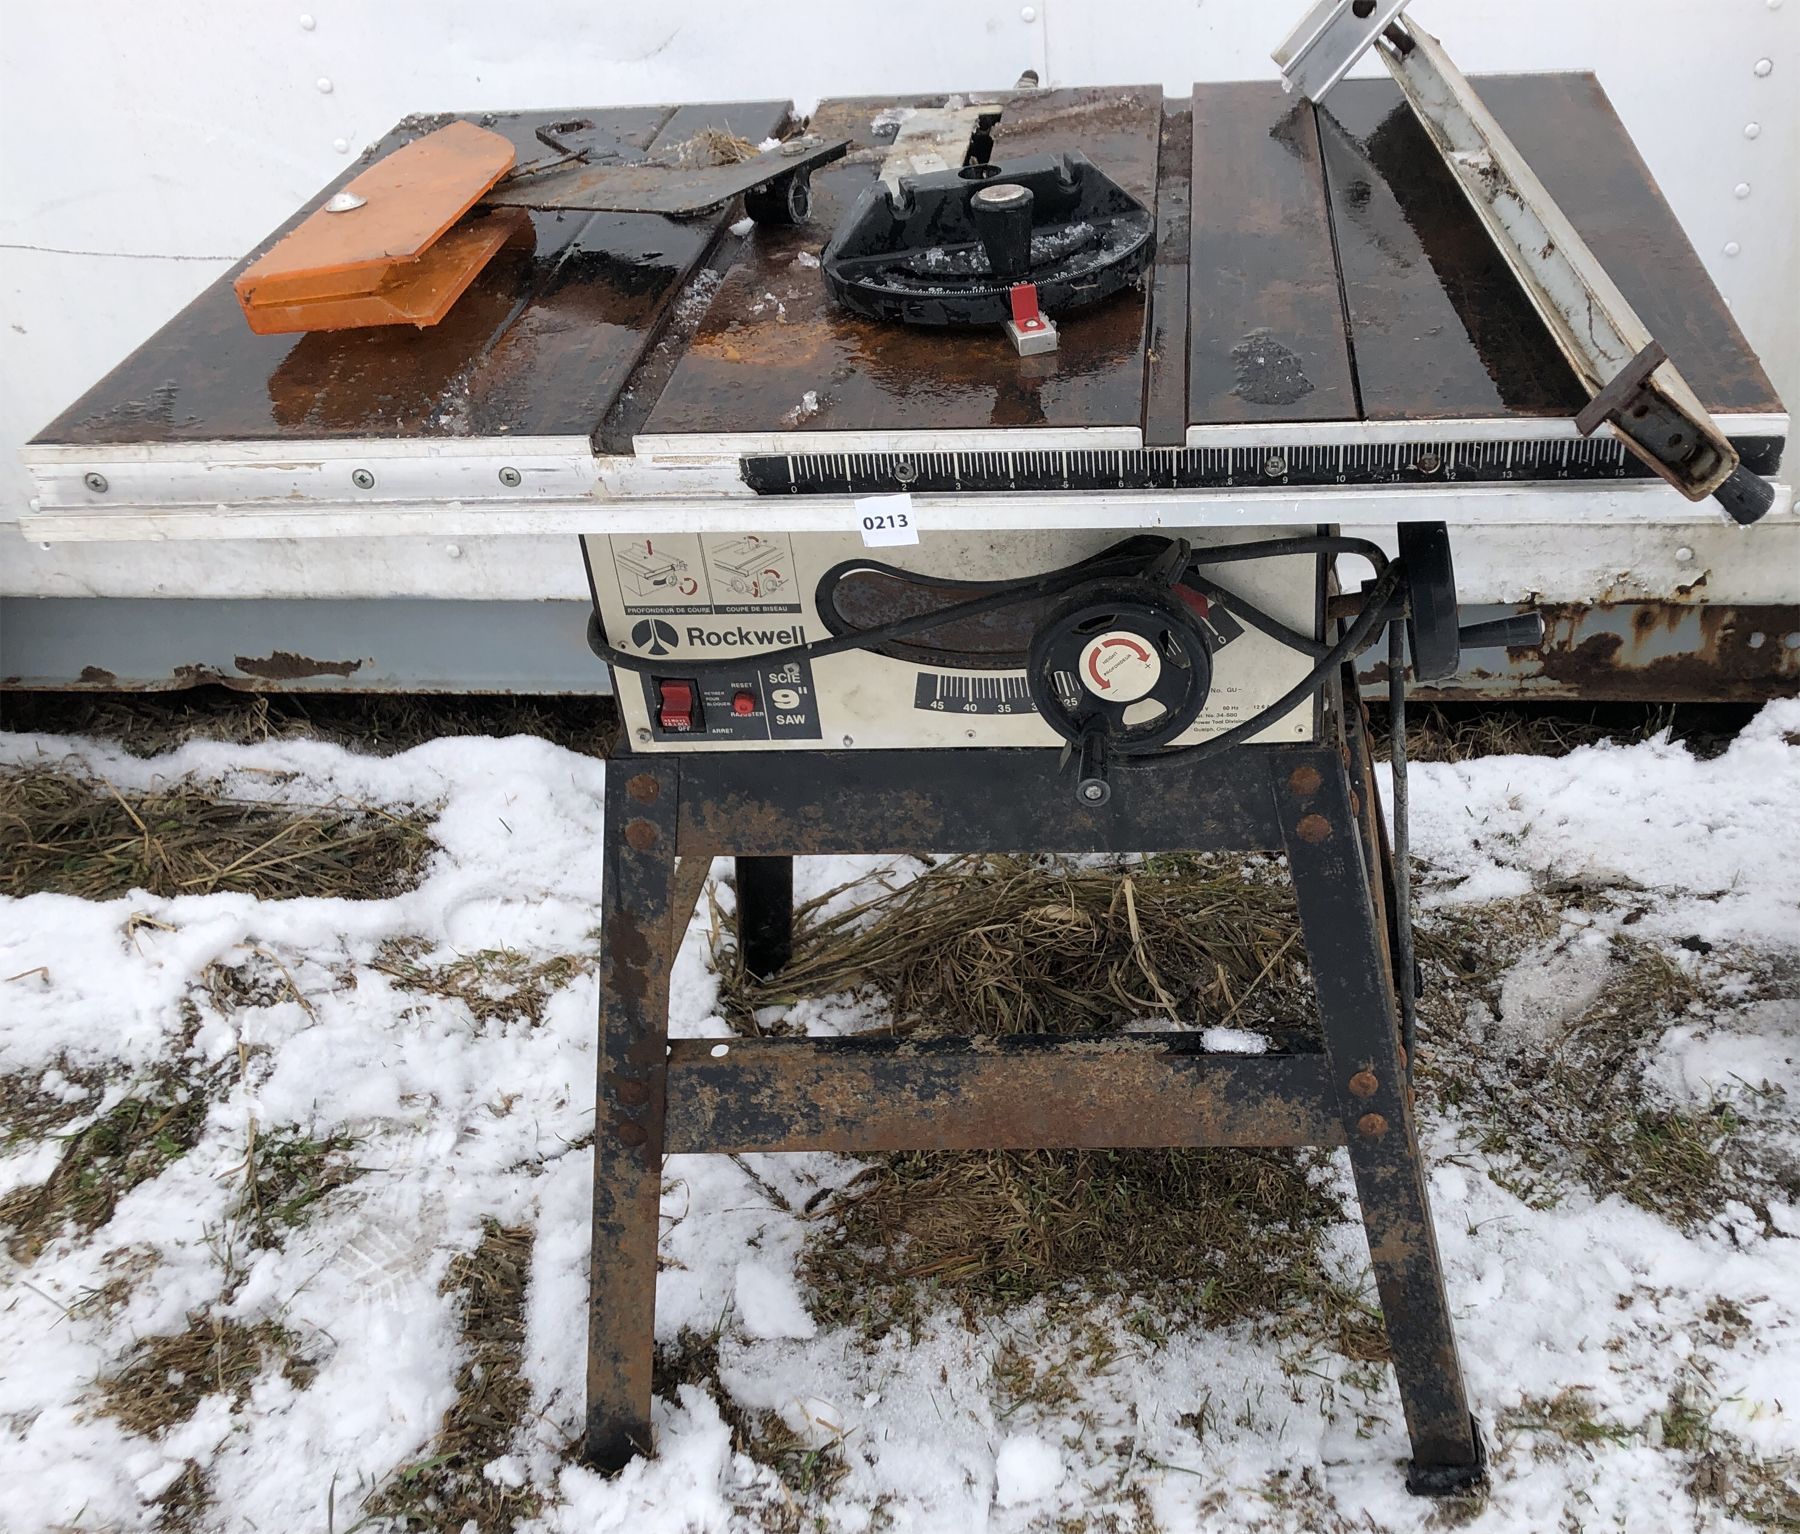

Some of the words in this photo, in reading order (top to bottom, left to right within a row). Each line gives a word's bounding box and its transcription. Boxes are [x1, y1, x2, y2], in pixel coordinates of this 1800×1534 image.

[790, 485, 798, 494] 0
[901, 483, 908, 491] 2
[955, 482, 962, 490] 3
[1009, 481, 1016, 489] 4
[1118, 480, 1124, 488] 6
[1171, 479, 1177, 487] 7
[1227, 478, 1233, 486] 8
[1282, 476, 1289, 484] 9
[1336, 474, 1346, 483] 10
[1446, 472, 1456, 480] 12
[1502, 470, 1512, 479] 13
[1557, 470, 1568, 478] 14
[1615, 468, 1625, 477] 15
[862, 513, 909, 531] 0213
[686, 625, 806, 647] Rockwell
[768, 672, 801, 684] SCIE
[930, 701, 945, 710] 45
[962, 703, 978, 712] 40
[997, 704, 1012, 713] 35
[775, 714, 806, 725] SAW
